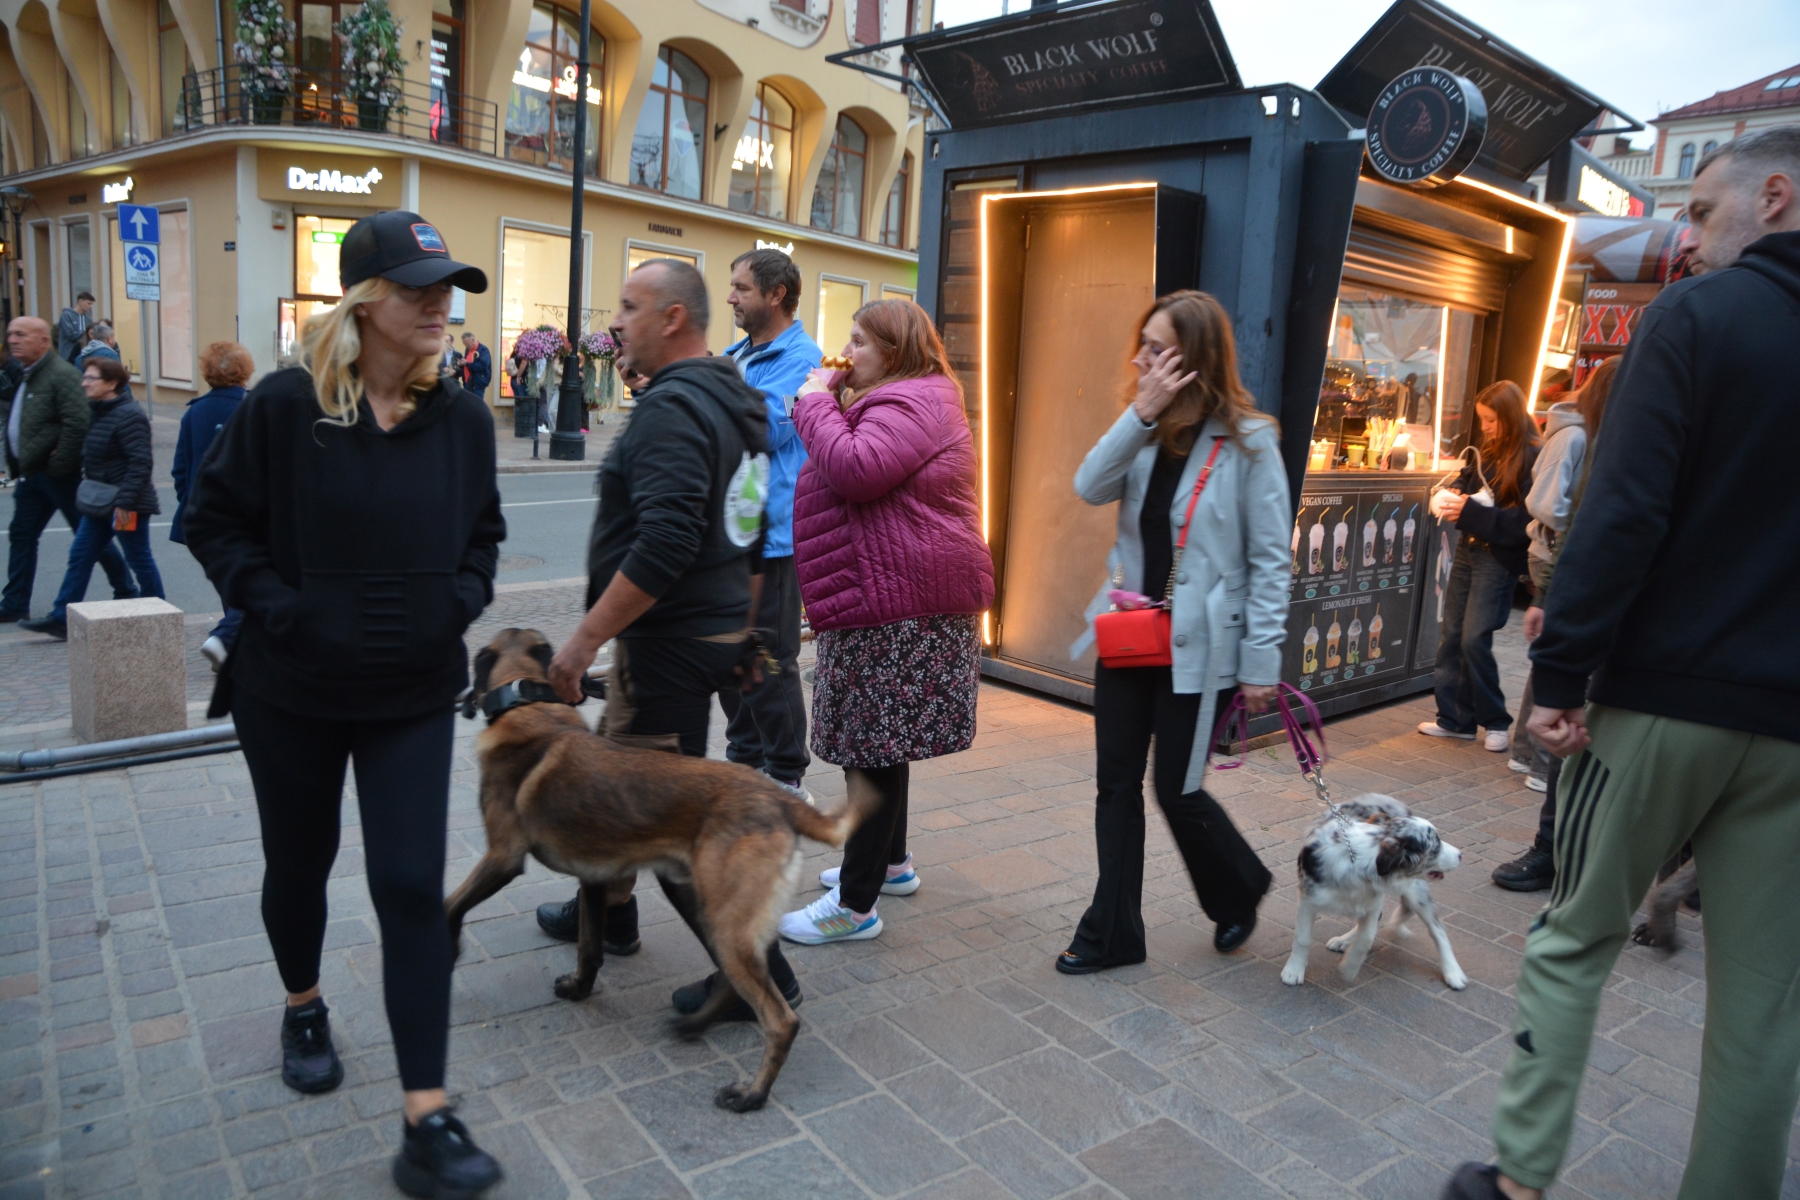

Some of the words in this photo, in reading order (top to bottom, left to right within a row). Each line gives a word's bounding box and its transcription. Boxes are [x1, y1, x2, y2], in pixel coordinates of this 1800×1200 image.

[1001, 43, 1084, 76] BLACK
[1085, 28, 1158, 61] WOLF
[1015, 70, 1098, 95] SPECIALTY
[1109, 59, 1172, 80] COFFEE
[1379, 72, 1422, 109] BLACK
[1430, 72, 1461, 102] WOLF
[1489, 83, 1555, 131] WOLF
[1370, 132, 1415, 179] SPECIALTY
[1421, 130, 1460, 173] COFFEE
[288, 167, 372, 194] Dr.Max
[1587, 289, 1617, 299] FOOD
[1580, 304, 1645, 346] XX
[1302, 497, 1322, 506] VEGAN
[1322, 495, 1343, 505] COFFEE
[1381, 493, 1404, 503] SPECIALS
[1321, 598, 1351, 611] LEMONADE
[1356, 595, 1372, 606] FRESH
